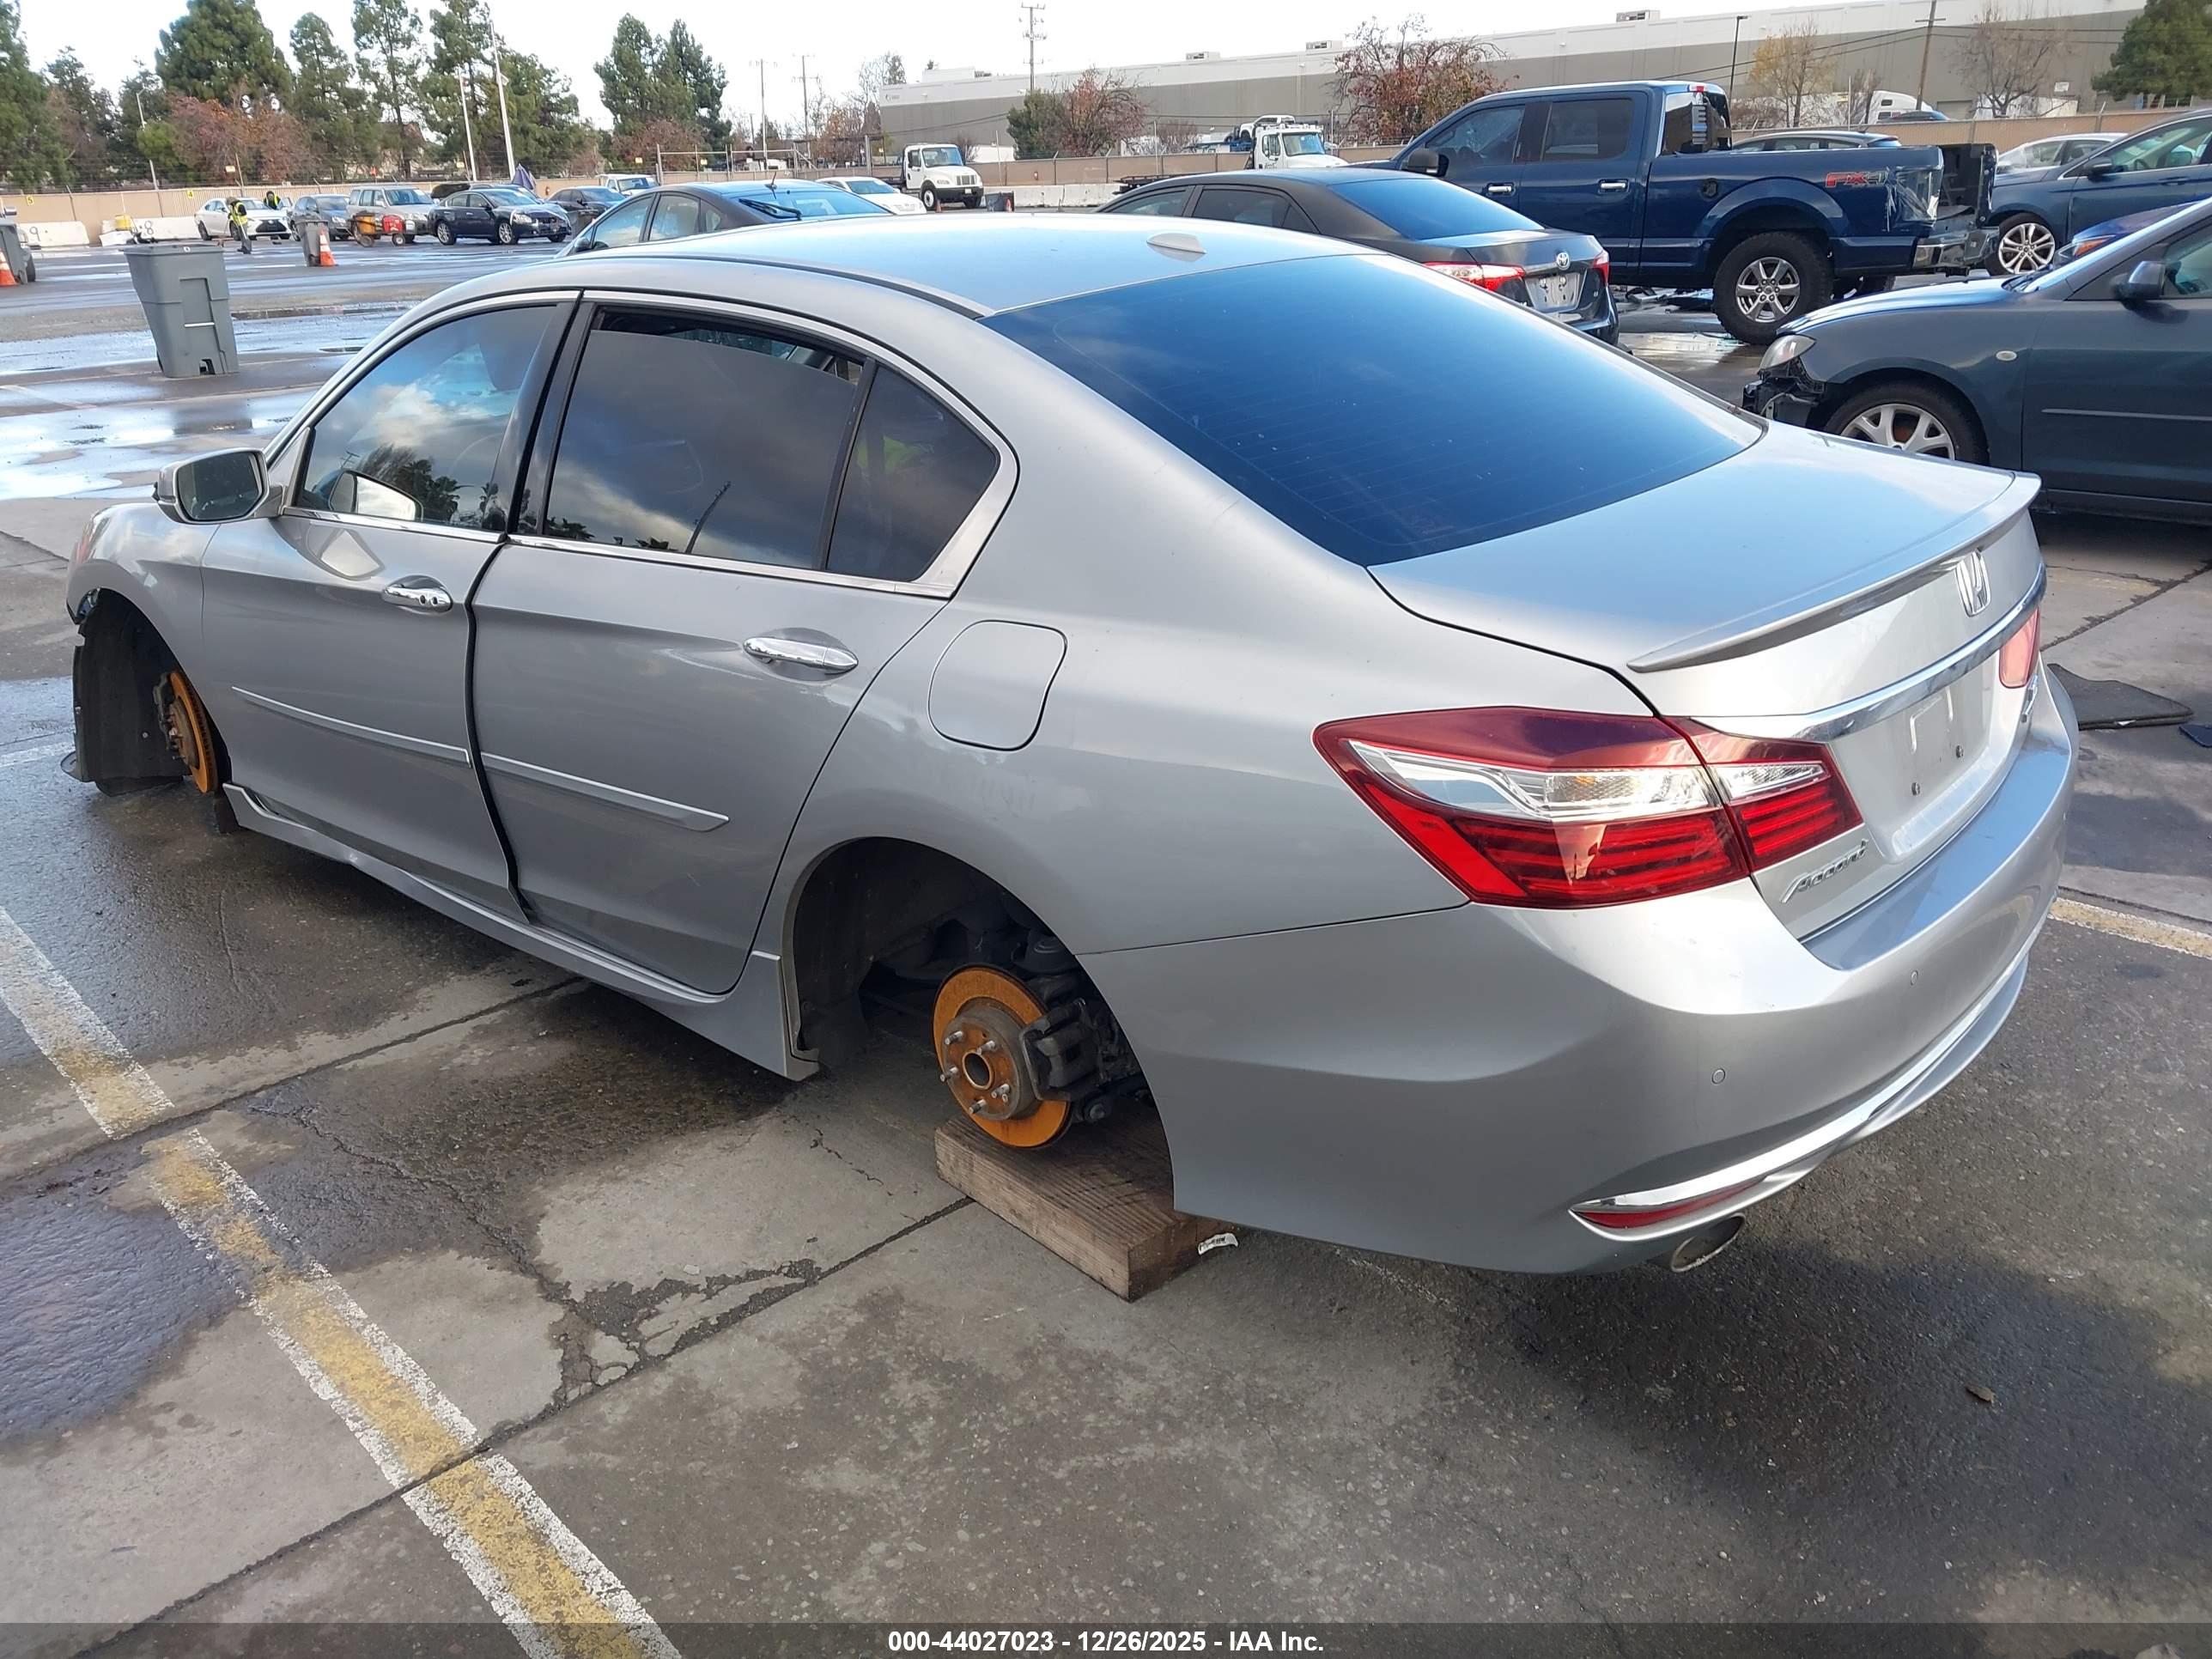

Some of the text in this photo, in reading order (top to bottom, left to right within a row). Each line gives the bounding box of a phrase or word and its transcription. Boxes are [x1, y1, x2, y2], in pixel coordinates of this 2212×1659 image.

[29, 226, 40, 241] 9
[144, 220, 154, 235] 8
[1779, 838, 1869, 903] Accord
